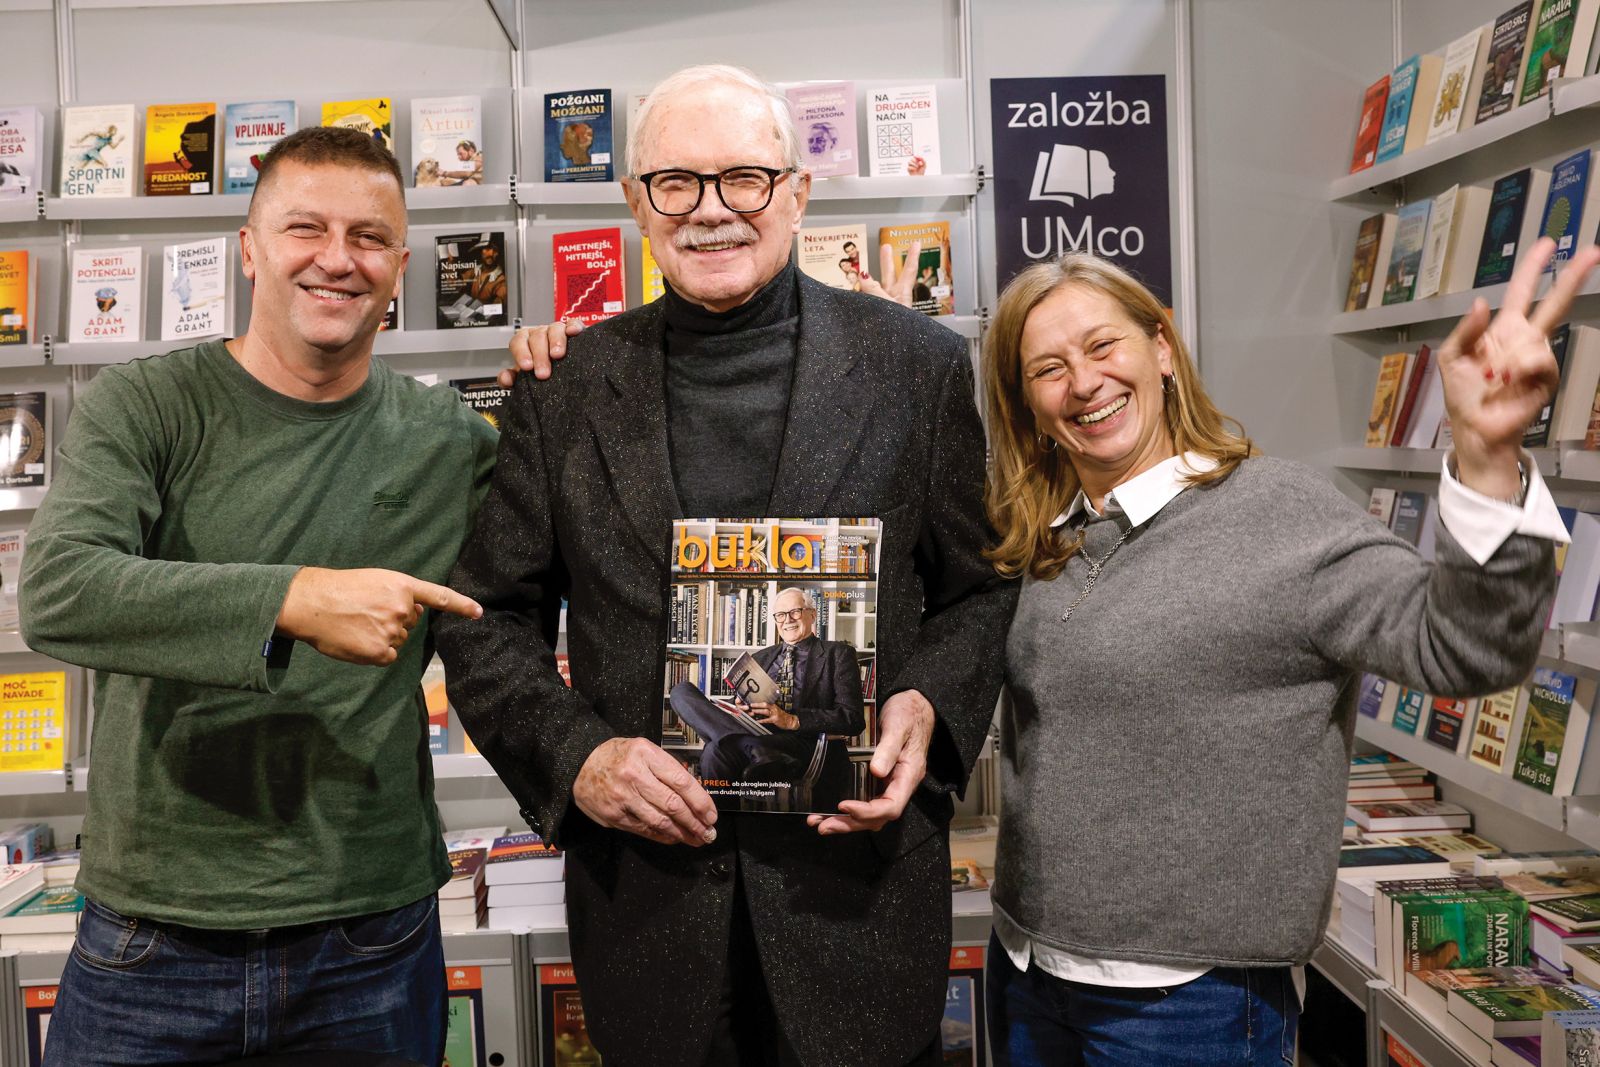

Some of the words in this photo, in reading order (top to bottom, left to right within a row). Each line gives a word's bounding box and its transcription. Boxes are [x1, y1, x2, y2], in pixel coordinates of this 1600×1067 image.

[551, 94, 605, 108] POŽGANI
[875, 94, 889, 102] NA
[551, 105, 605, 118] MOŽGANI
[806, 106, 837, 114] MILTONA
[875, 100, 931, 112] DRUGAČEN
[1008, 91, 1150, 128] založba
[806, 111, 845, 120] ERICKSONA
[876, 112, 906, 121] NAČIN
[235, 122, 286, 138] VPLIVANJE
[422, 118, 475, 132] Artur
[68, 166, 125, 182] ŠPORTNI
[151, 172, 207, 182] PREDANOST
[67, 183, 95, 196] GEN
[1021, 216, 1145, 259] UMco
[558, 240, 613, 253] PAMETNEJŠI,
[565, 251, 605, 261] HITREJŠI,
[92, 257, 123, 267] SKRITI
[184, 256, 218, 270] ENKRAT
[441, 260, 477, 271] Napisani
[587, 259, 616, 269] BOLJŠI
[77, 268, 136, 278] POTENCIALI
[441, 271, 458, 280] svet
[88, 317, 122, 326] ADAM
[178, 312, 210, 323] ADAM
[83, 326, 125, 336] GRANT
[174, 320, 213, 333] GRANT
[475, 398, 503, 408] KLJUČ
[678, 525, 814, 569] bukla
[823, 590, 865, 600] buklaplus
[3, 680, 27, 690] MOČ
[3, 690, 44, 699] NAVADE
[1534, 688, 1567, 705] NICHOLLS
[1518, 762, 1538, 783] Tukaj
[1538, 773, 1551, 785] ste
[1411, 915, 1419, 953] Florence
